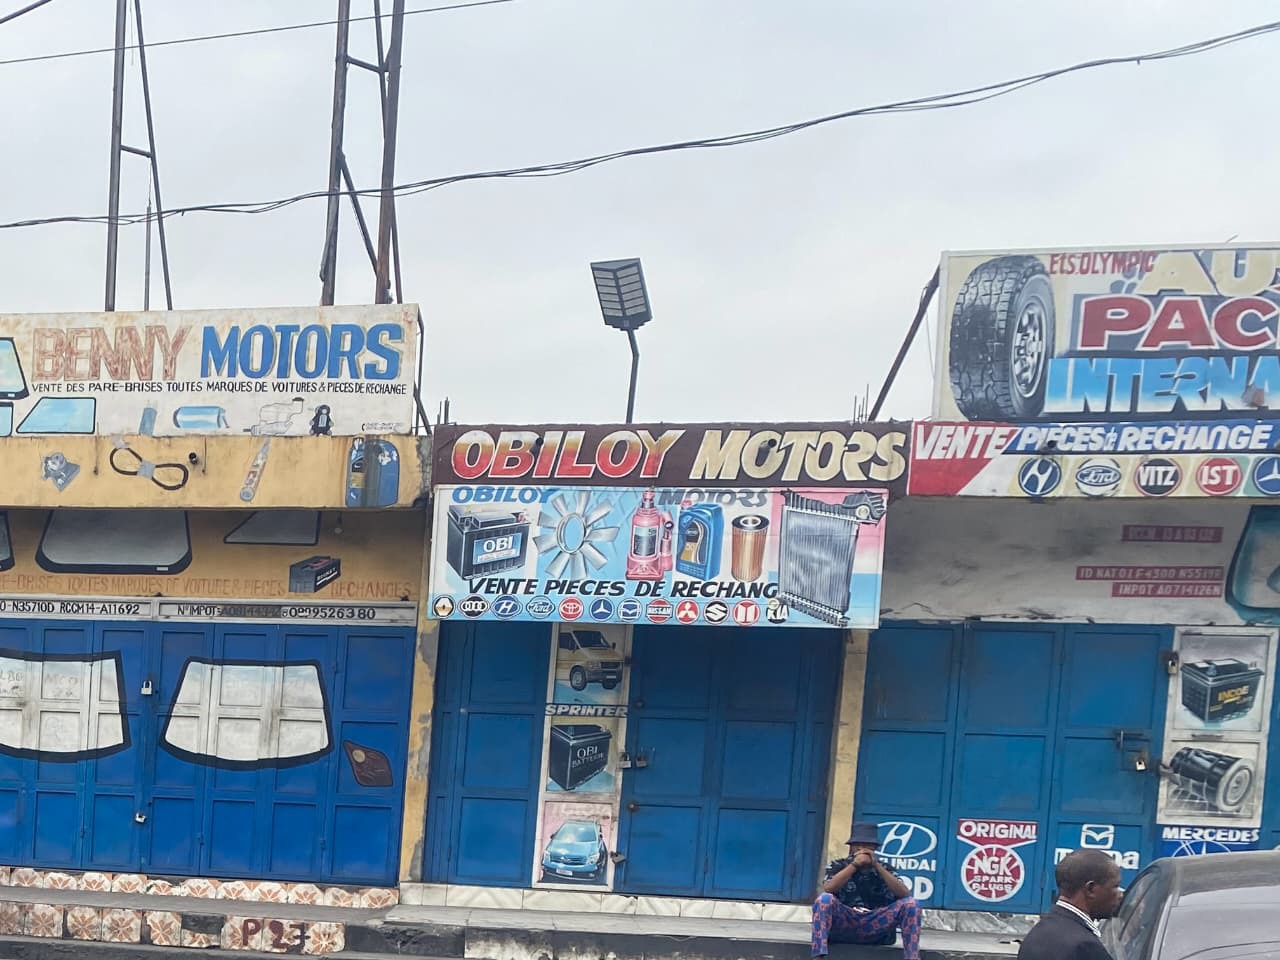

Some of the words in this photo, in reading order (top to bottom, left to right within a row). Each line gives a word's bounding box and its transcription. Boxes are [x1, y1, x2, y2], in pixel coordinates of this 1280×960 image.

[31, 325, 192, 382] BENNY
[200, 323, 405, 381] MOTORS
[32, 383, 63, 393] VENTE
[66, 383, 85, 392] DES
[88, 382, 163, 393] PARE-BRISES
[167, 382, 203, 392] TOUTES
[206, 381, 252, 393] MARQUES
[254, 382, 268, 392] DE
[271, 382, 318, 393] VOITURES
[319, 382, 326, 392] &
[327, 382, 354, 393] PIECES
[355, 382, 365, 393] DE
[365, 383, 407, 394] RECHANGE
[915, 424, 1011, 459] VENTE
[1016, 426, 1106, 451] PIECES
[1118, 424, 1274, 451] RECHANGE
[452, 429, 686, 480] OBILOY
[688, 430, 908, 483] MOTORS
[1139, 465, 1177, 487] VITZ
[1200, 464, 1238, 486] IST
[452, 486, 560, 504] OBILOY
[658, 488, 768, 508] MOTORS
[483, 536, 514, 552] OBI
[469, 578, 538, 595] VENTE
[543, 580, 626, 596] PIECES
[634, 581, 666, 597] DE
[670, 581, 779, 599] RECHANG
[545, 704, 628, 718] SPRINTER
[959, 821, 1037, 840] ORIGINAL
[1161, 826, 1260, 842] MERCEDES
[973, 855, 1013, 877] NGK
[973, 875, 1013, 884] SPARK
